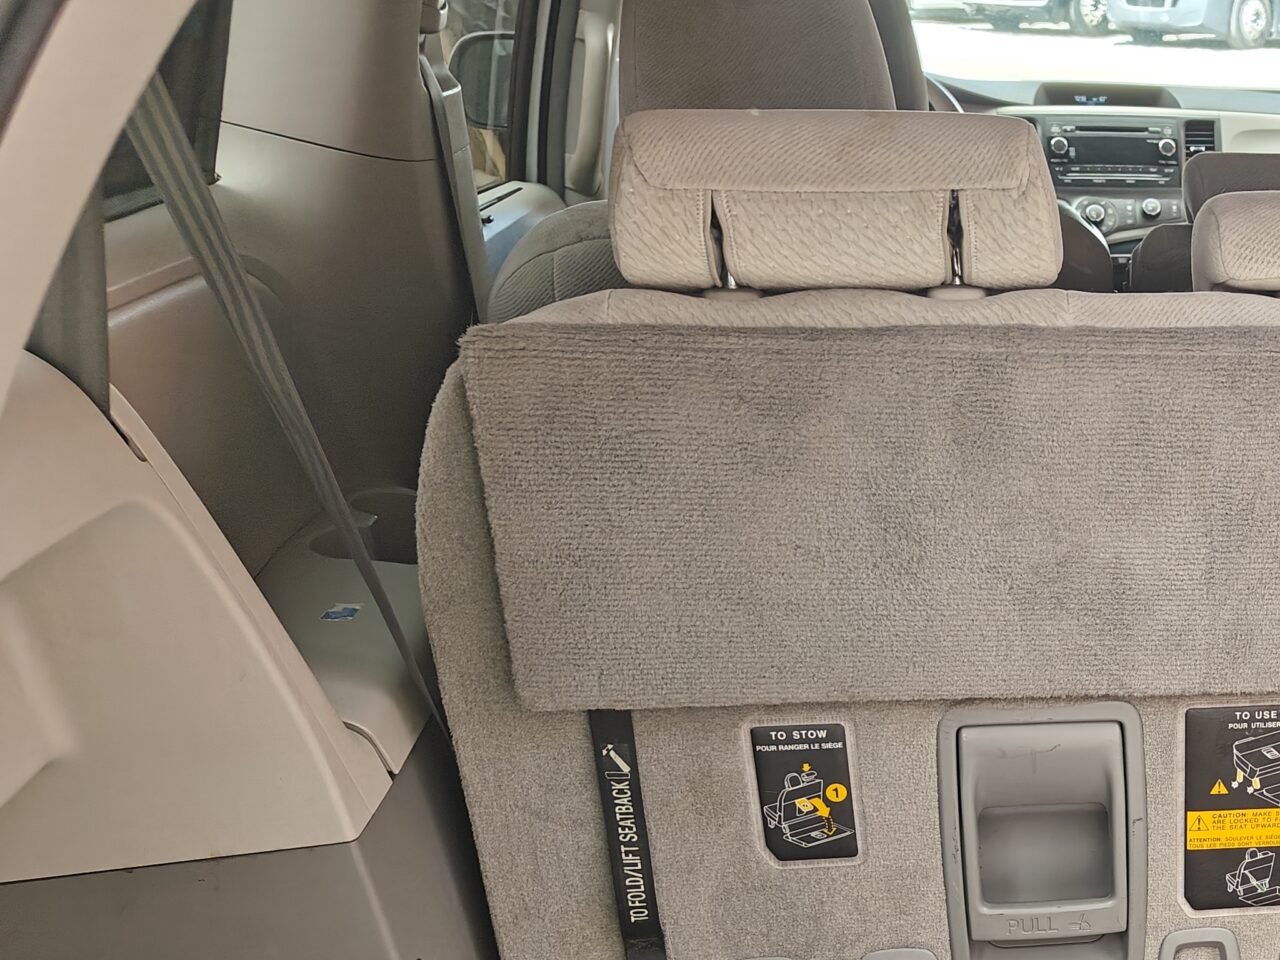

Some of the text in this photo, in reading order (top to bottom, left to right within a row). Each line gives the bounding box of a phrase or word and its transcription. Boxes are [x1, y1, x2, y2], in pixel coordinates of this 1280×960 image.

[1234, 711, 1250, 720] TO
[1255, 710, 1277, 719] USE
[1251, 721, 1280, 729] UTILISER
[770, 729, 827, 740] TO STOW
[779, 743, 809, 751] RANGER
[832, 788, 839, 798] 1
[612, 781, 648, 923] TO FOLD/LIFT SEATBACK
[1006, 916, 1058, 935] PULL
